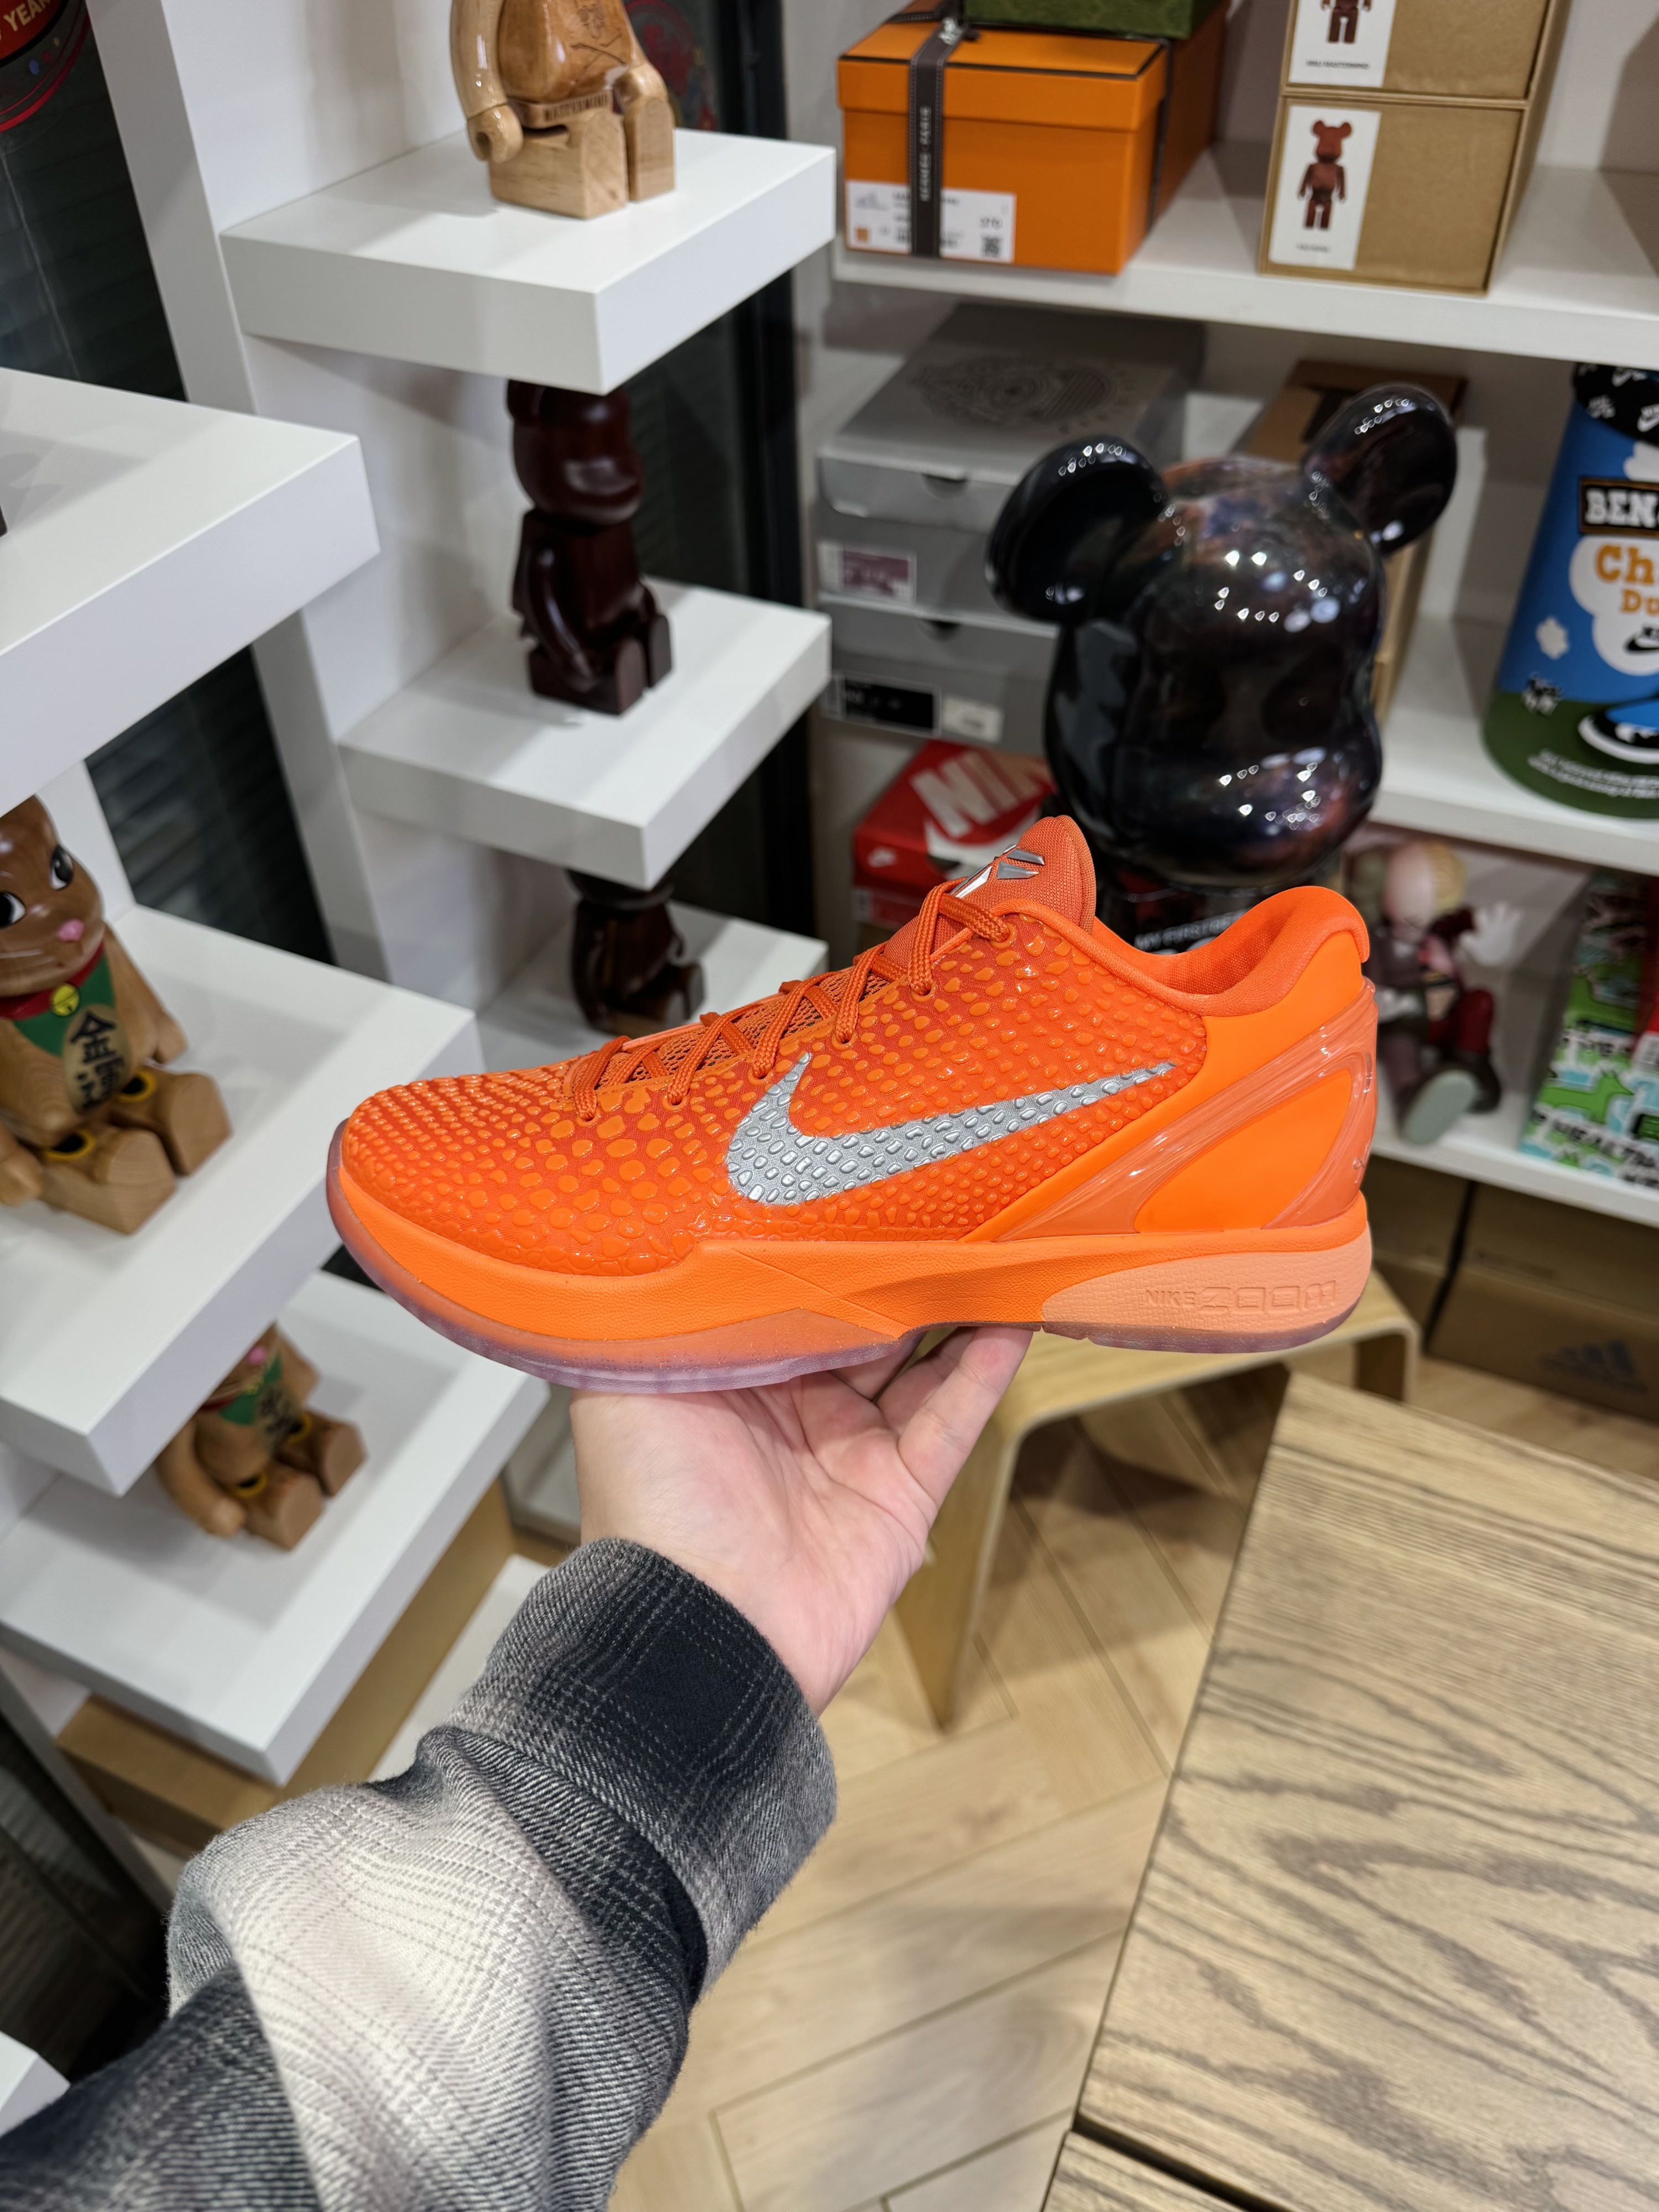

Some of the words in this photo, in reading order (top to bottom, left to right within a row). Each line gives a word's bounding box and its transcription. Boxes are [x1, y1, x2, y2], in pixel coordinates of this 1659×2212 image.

[1585, 488, 1658, 528] BEN
[1145, 1290, 1196, 1307] NIKE
[1198, 1280, 1336, 1314] ZOOM
